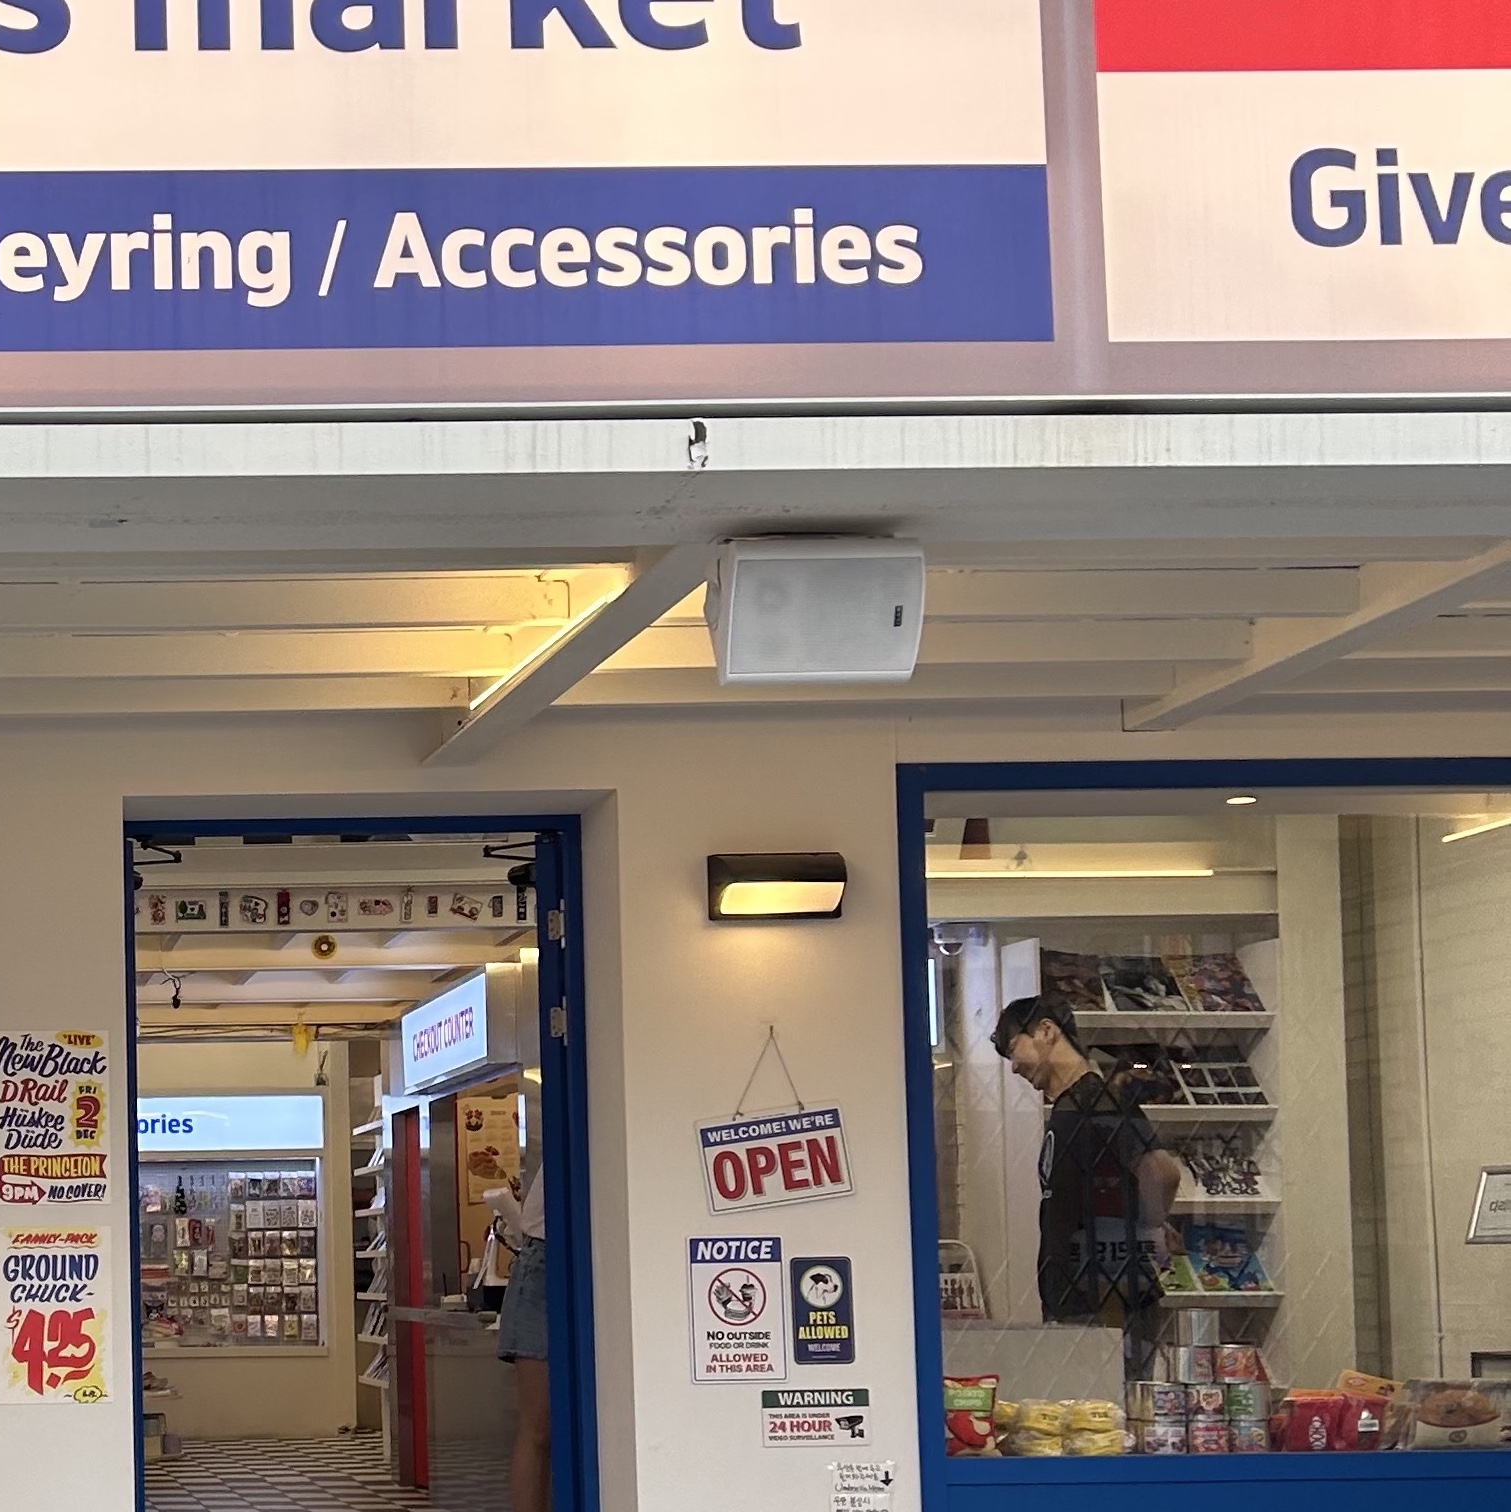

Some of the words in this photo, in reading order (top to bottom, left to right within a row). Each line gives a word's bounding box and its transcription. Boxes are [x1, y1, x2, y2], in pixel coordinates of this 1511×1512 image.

[373, 208, 923, 289] Accessories
[20, 1034, 45, 1052] The
[39, 1043, 107, 1078] Black
[78, 1085, 97, 1094] FRI
[76, 1095, 101, 1129] 2
[76, 1129, 96, 1139] DEC
[708, 1122, 787, 1144] WELCOME!
[788, 1113, 835, 1132] WE'RE
[2, 1157, 28, 1174] THE
[30, 1156, 101, 1177] PRINCETON
[713, 1135, 846, 1202] OPEN
[2, 1183, 39, 1201] 9PM
[48, 1184, 65, 1200] NO
[66, 1182, 107, 1200] COVER!
[697, 1240, 773, 1260] NOTICE
[3, 1254, 99, 1282] GROUND
[809, 1311, 837, 1325] PETS
[706, 1331, 725, 1341] NO
[726, 1331, 772, 1341] OUTSIDE
[798, 1325, 849, 1340] ALLOWED
[745, 1341, 769, 1349] DRINK
[710, 1353, 769, 1363] ALLOWED
[706, 1365, 717, 1374] IN
[718, 1364, 743, 1373] THIS
[745, 1363, 775, 1373] AREA
[777, 1391, 855, 1406] WARNING
[768, 1421, 787, 1433] 24
[790, 1420, 833, 1432] HOUR
